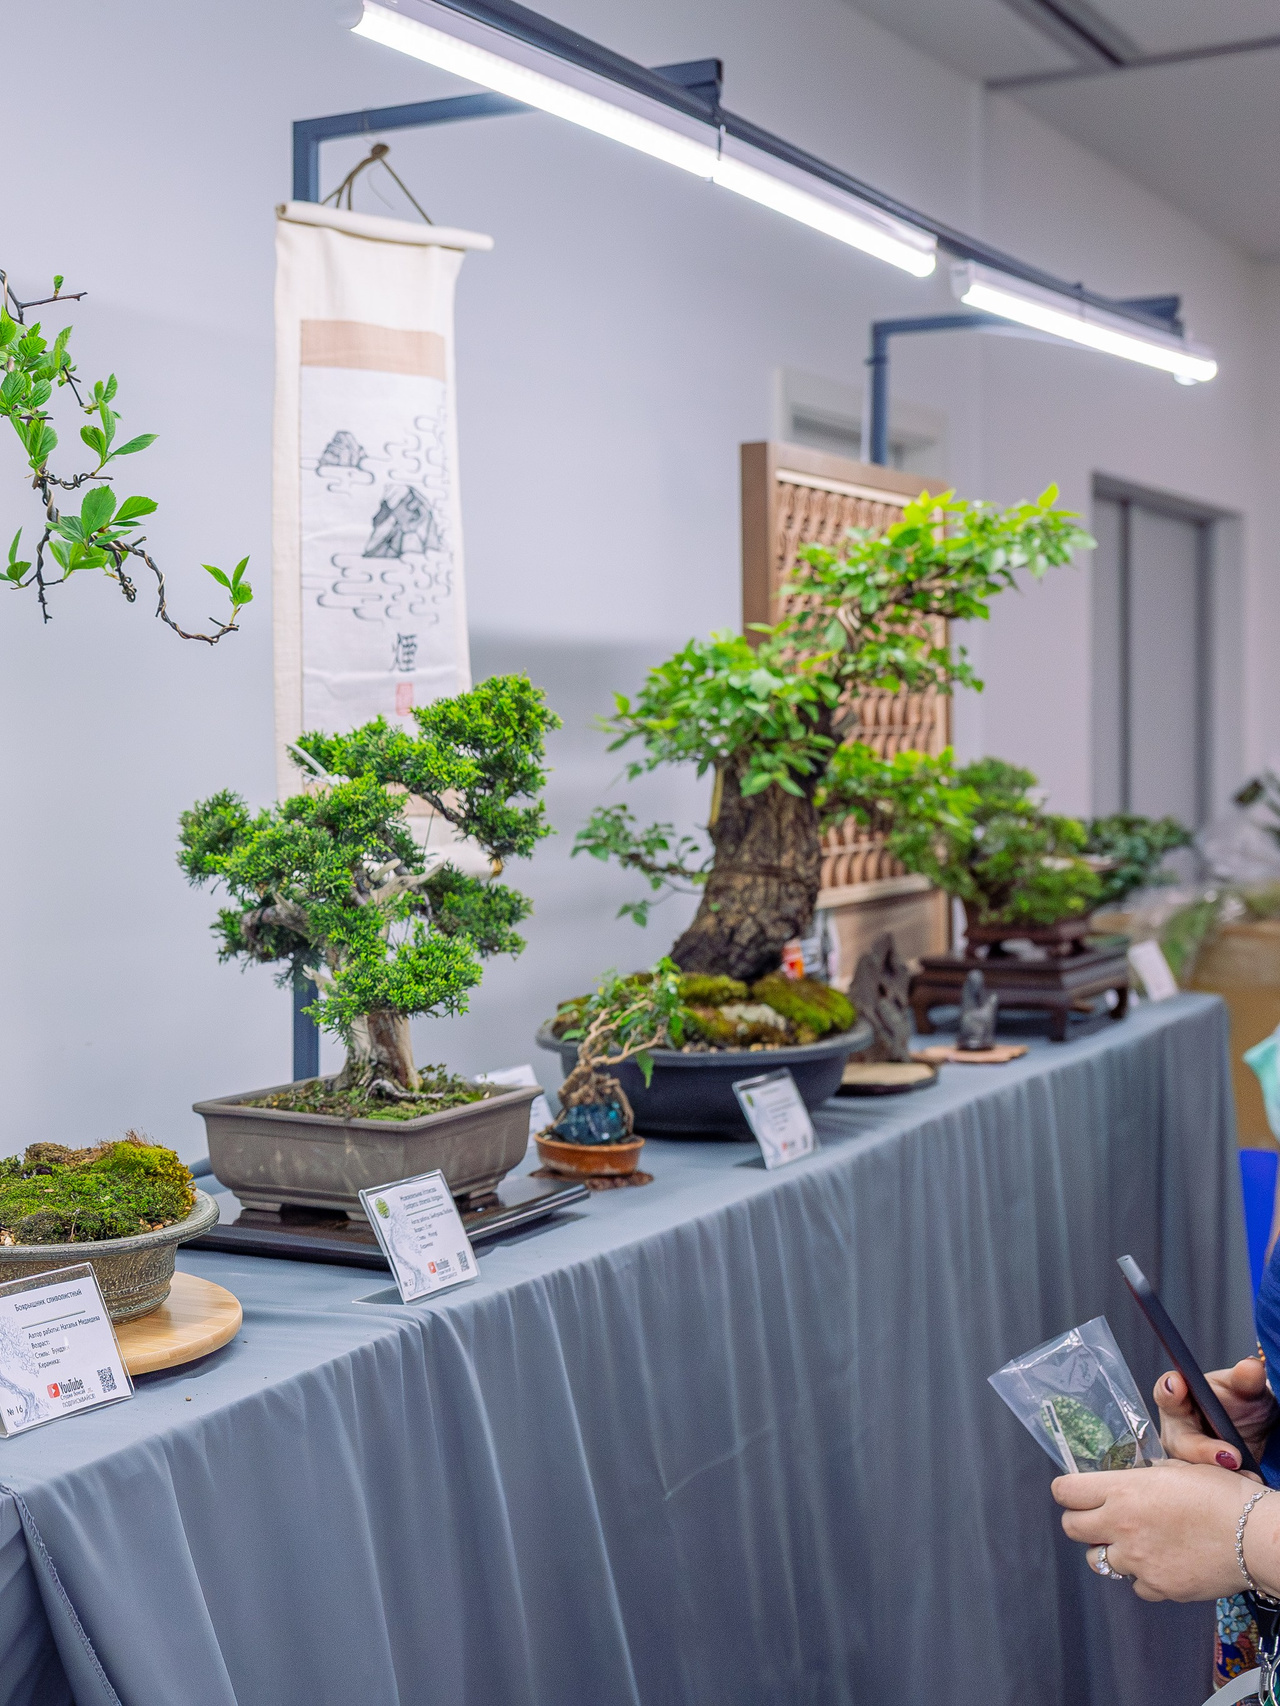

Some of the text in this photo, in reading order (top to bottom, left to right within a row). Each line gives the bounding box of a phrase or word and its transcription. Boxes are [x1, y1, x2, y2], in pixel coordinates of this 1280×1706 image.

[28, 1331, 42, 1340] Автор
[58, 1377, 84, 1394] YouTube
[16, 1405, 23, 1413] 16
